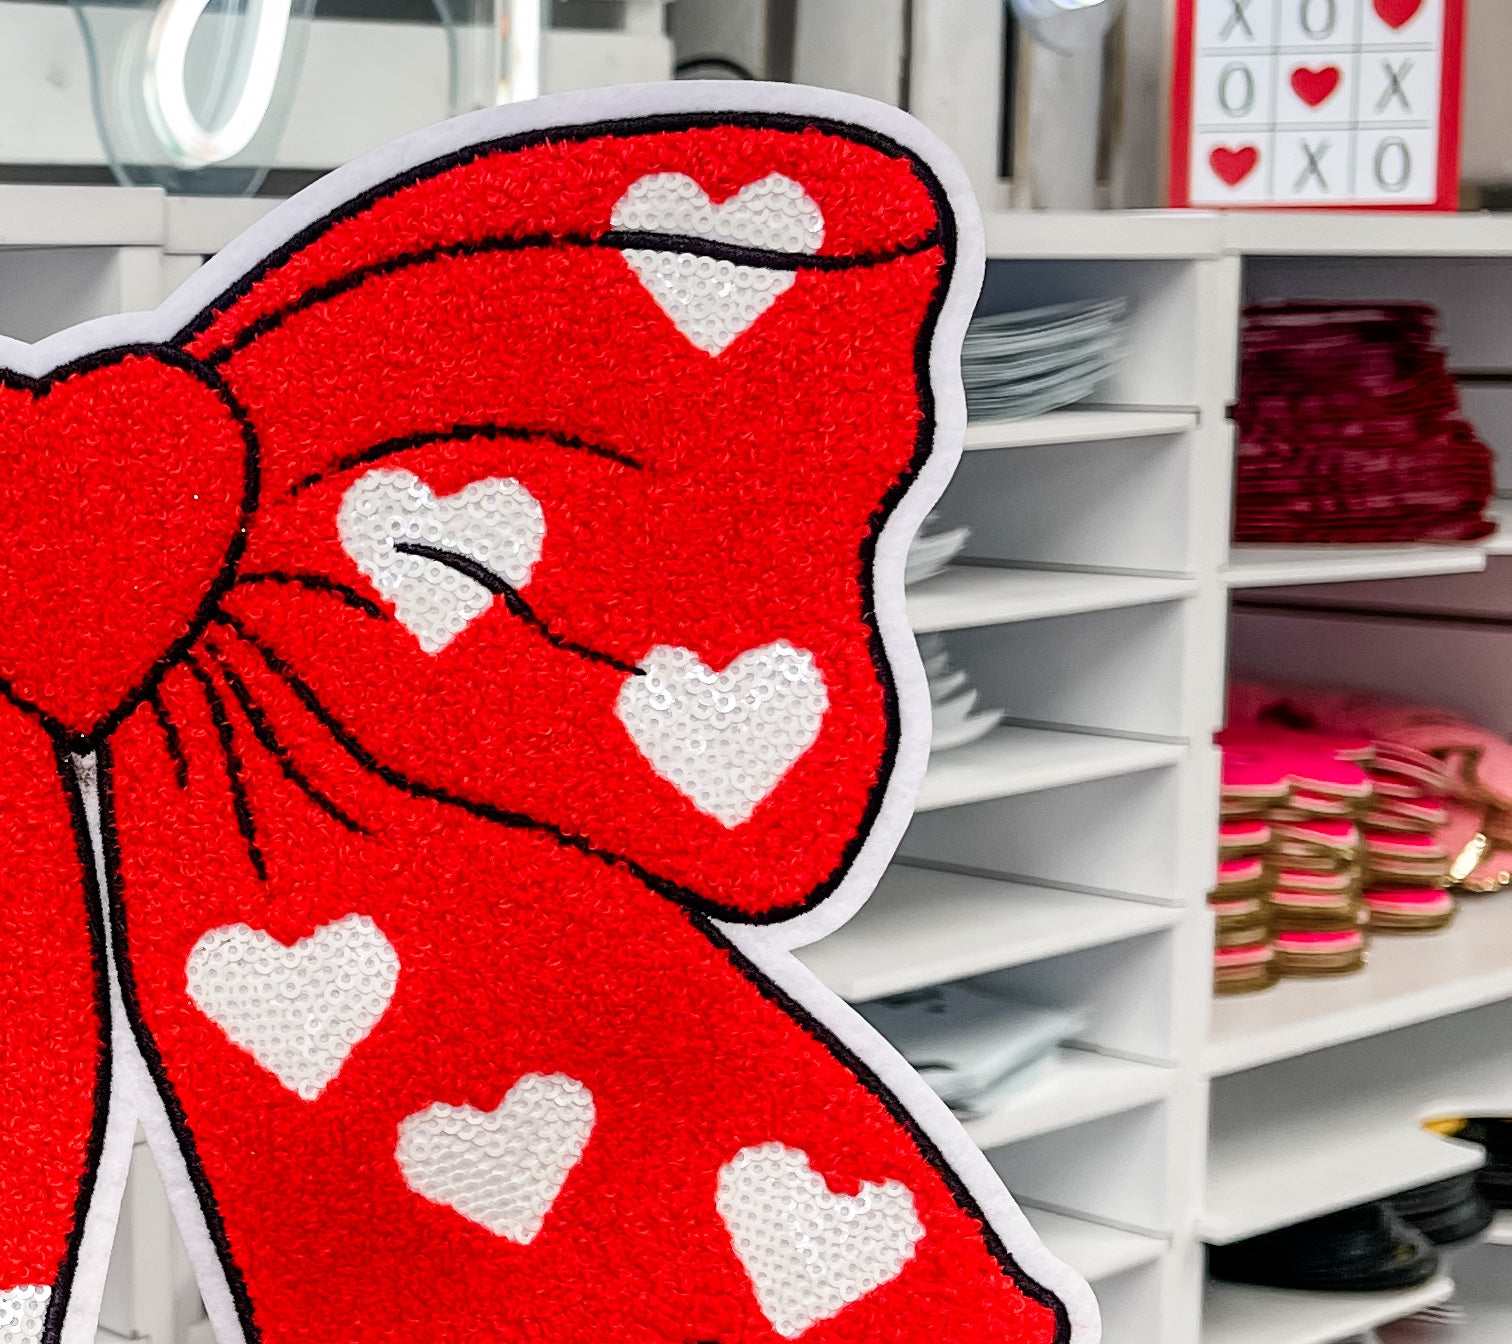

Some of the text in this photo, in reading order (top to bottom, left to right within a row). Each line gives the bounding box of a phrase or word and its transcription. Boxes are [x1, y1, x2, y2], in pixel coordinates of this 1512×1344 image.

[1217, 57, 1414, 118] O X
[1291, 135, 1412, 194] X O
